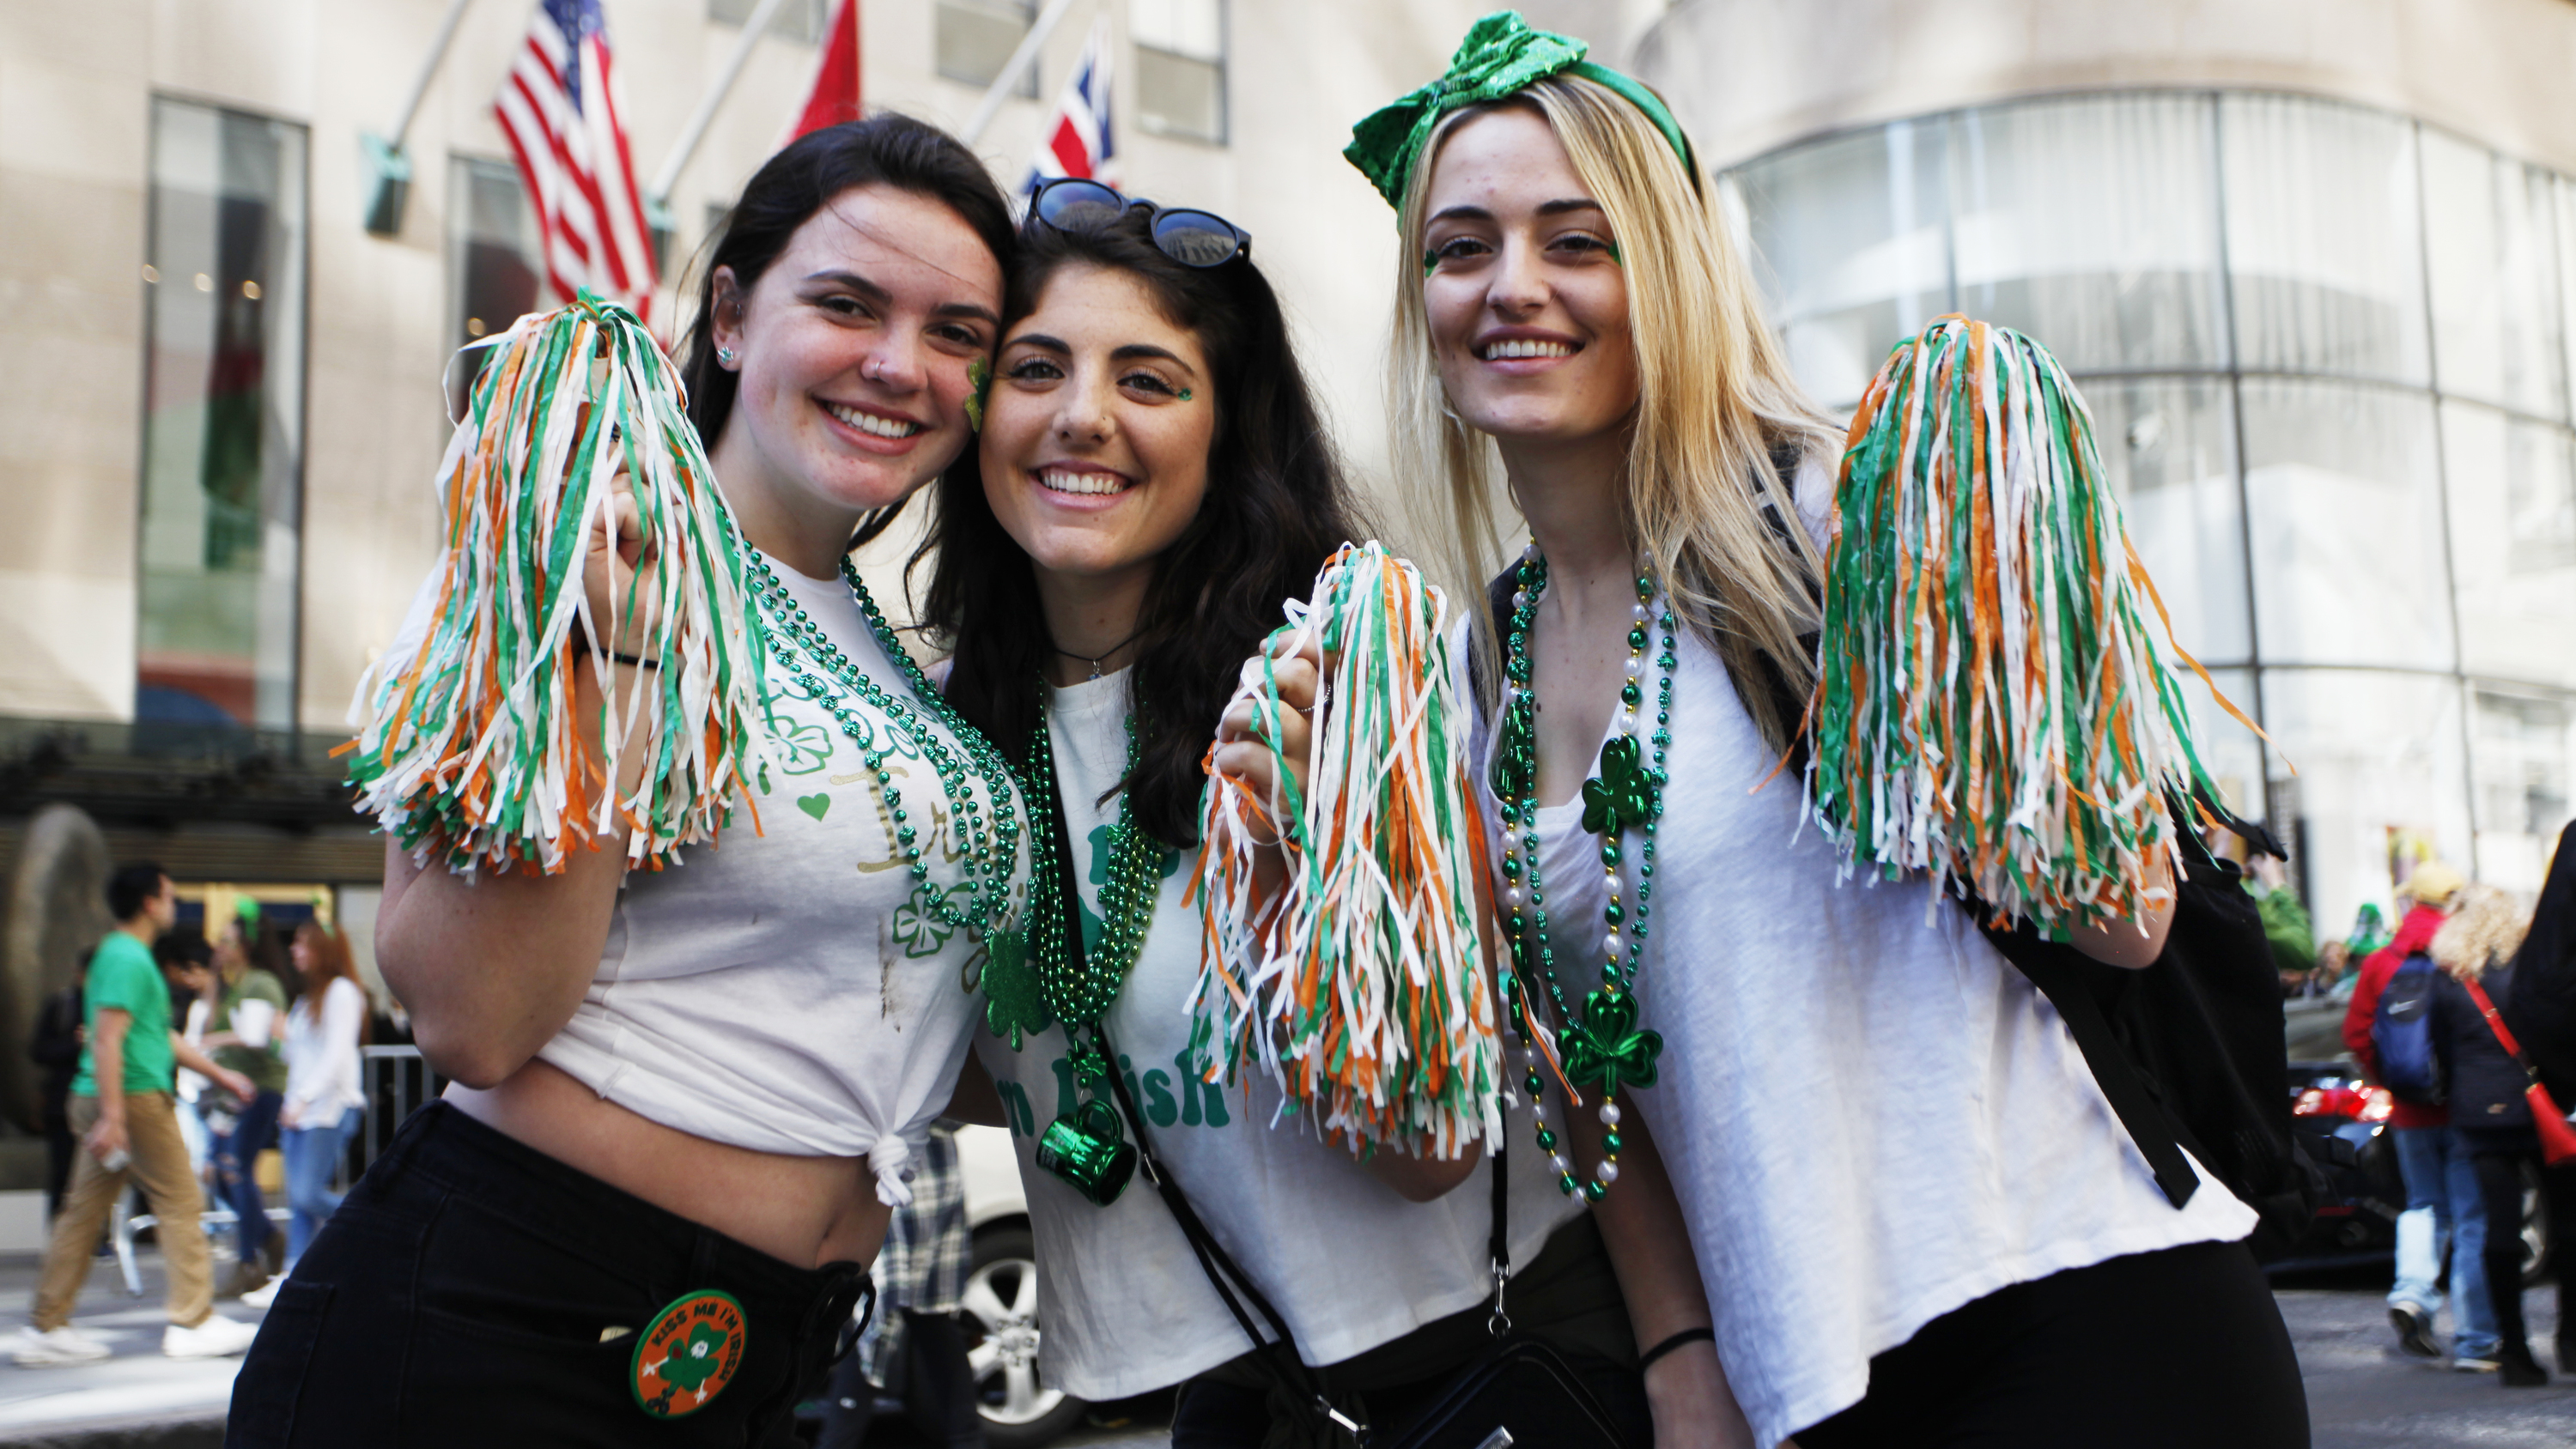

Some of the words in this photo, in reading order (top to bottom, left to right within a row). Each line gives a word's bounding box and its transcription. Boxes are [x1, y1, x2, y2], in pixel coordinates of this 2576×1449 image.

[693, 1301, 719, 1319] ME
[718, 1307, 739, 1331] I'M
[652, 1310, 687, 1347] KISS
[718, 1332, 741, 1381] IRISH
